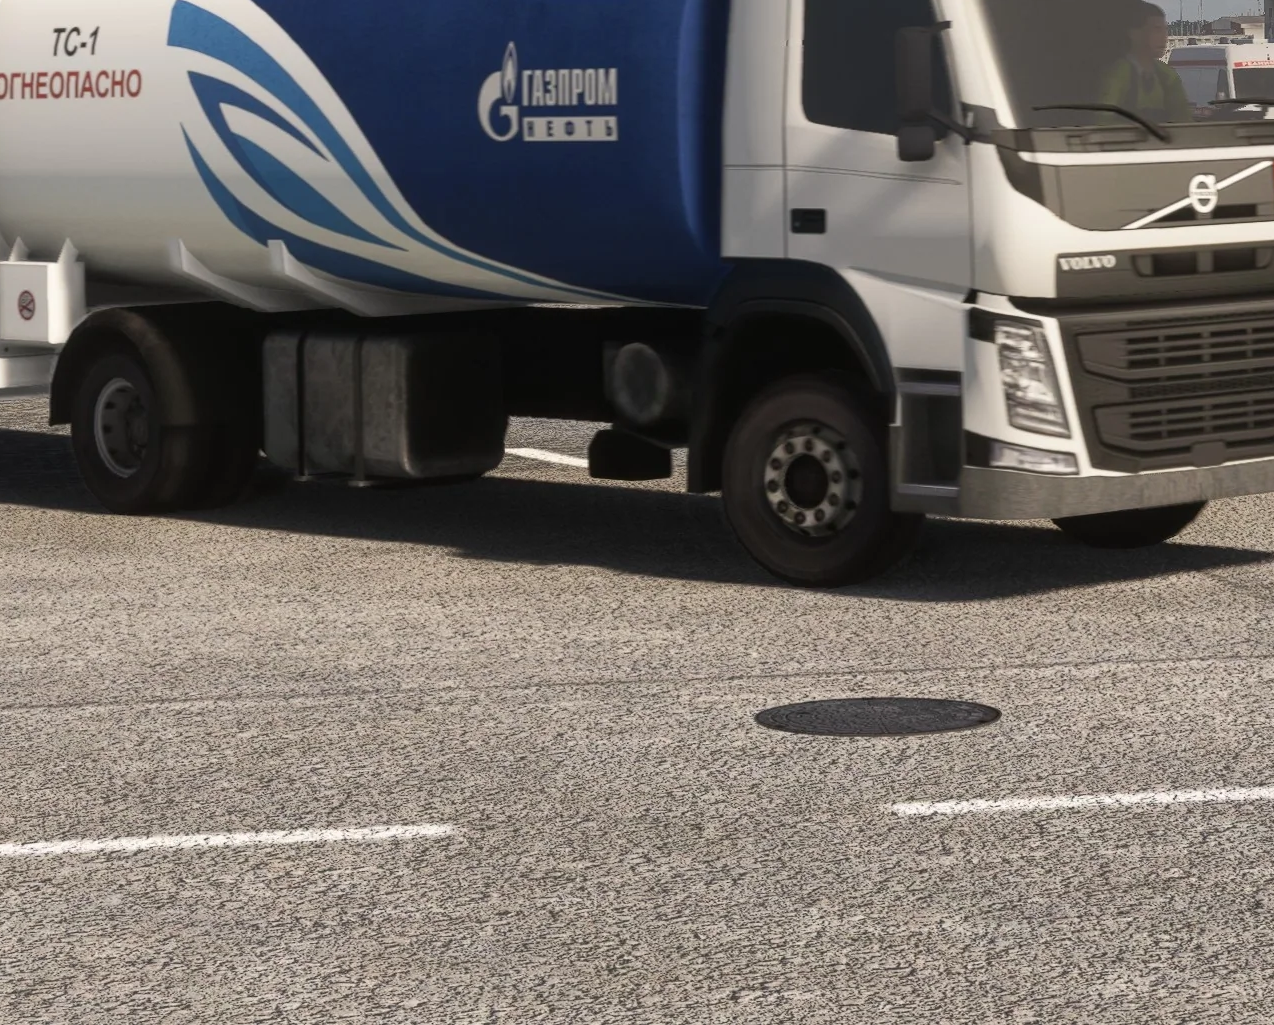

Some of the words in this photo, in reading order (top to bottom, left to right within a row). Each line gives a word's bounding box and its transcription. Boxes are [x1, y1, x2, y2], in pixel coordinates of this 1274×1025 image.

[52, 26, 99, 56] ТС-1
[522, 68, 618, 106] ГАЗПРОМ
[1058, 254, 1116, 271] VOLVO
